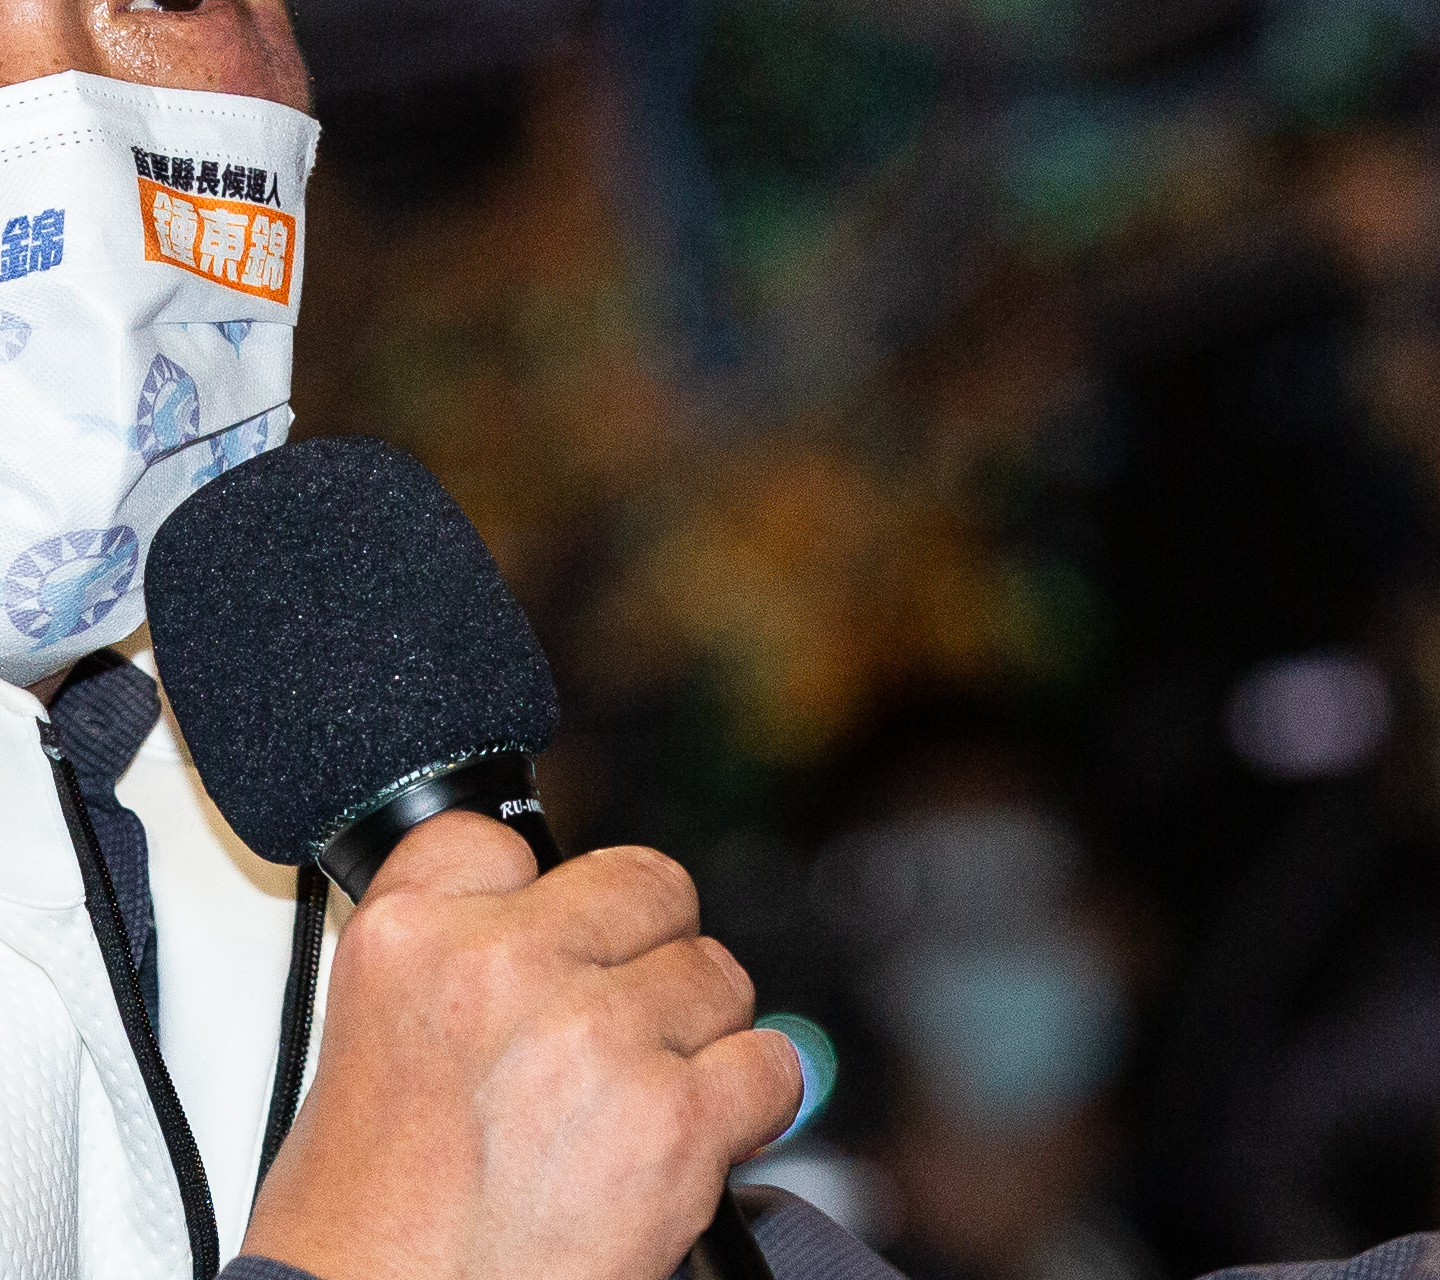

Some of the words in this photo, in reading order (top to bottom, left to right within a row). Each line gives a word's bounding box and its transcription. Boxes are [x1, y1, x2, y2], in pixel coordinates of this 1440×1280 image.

[131, 146, 281, 208] 苗栗縣長候選人
